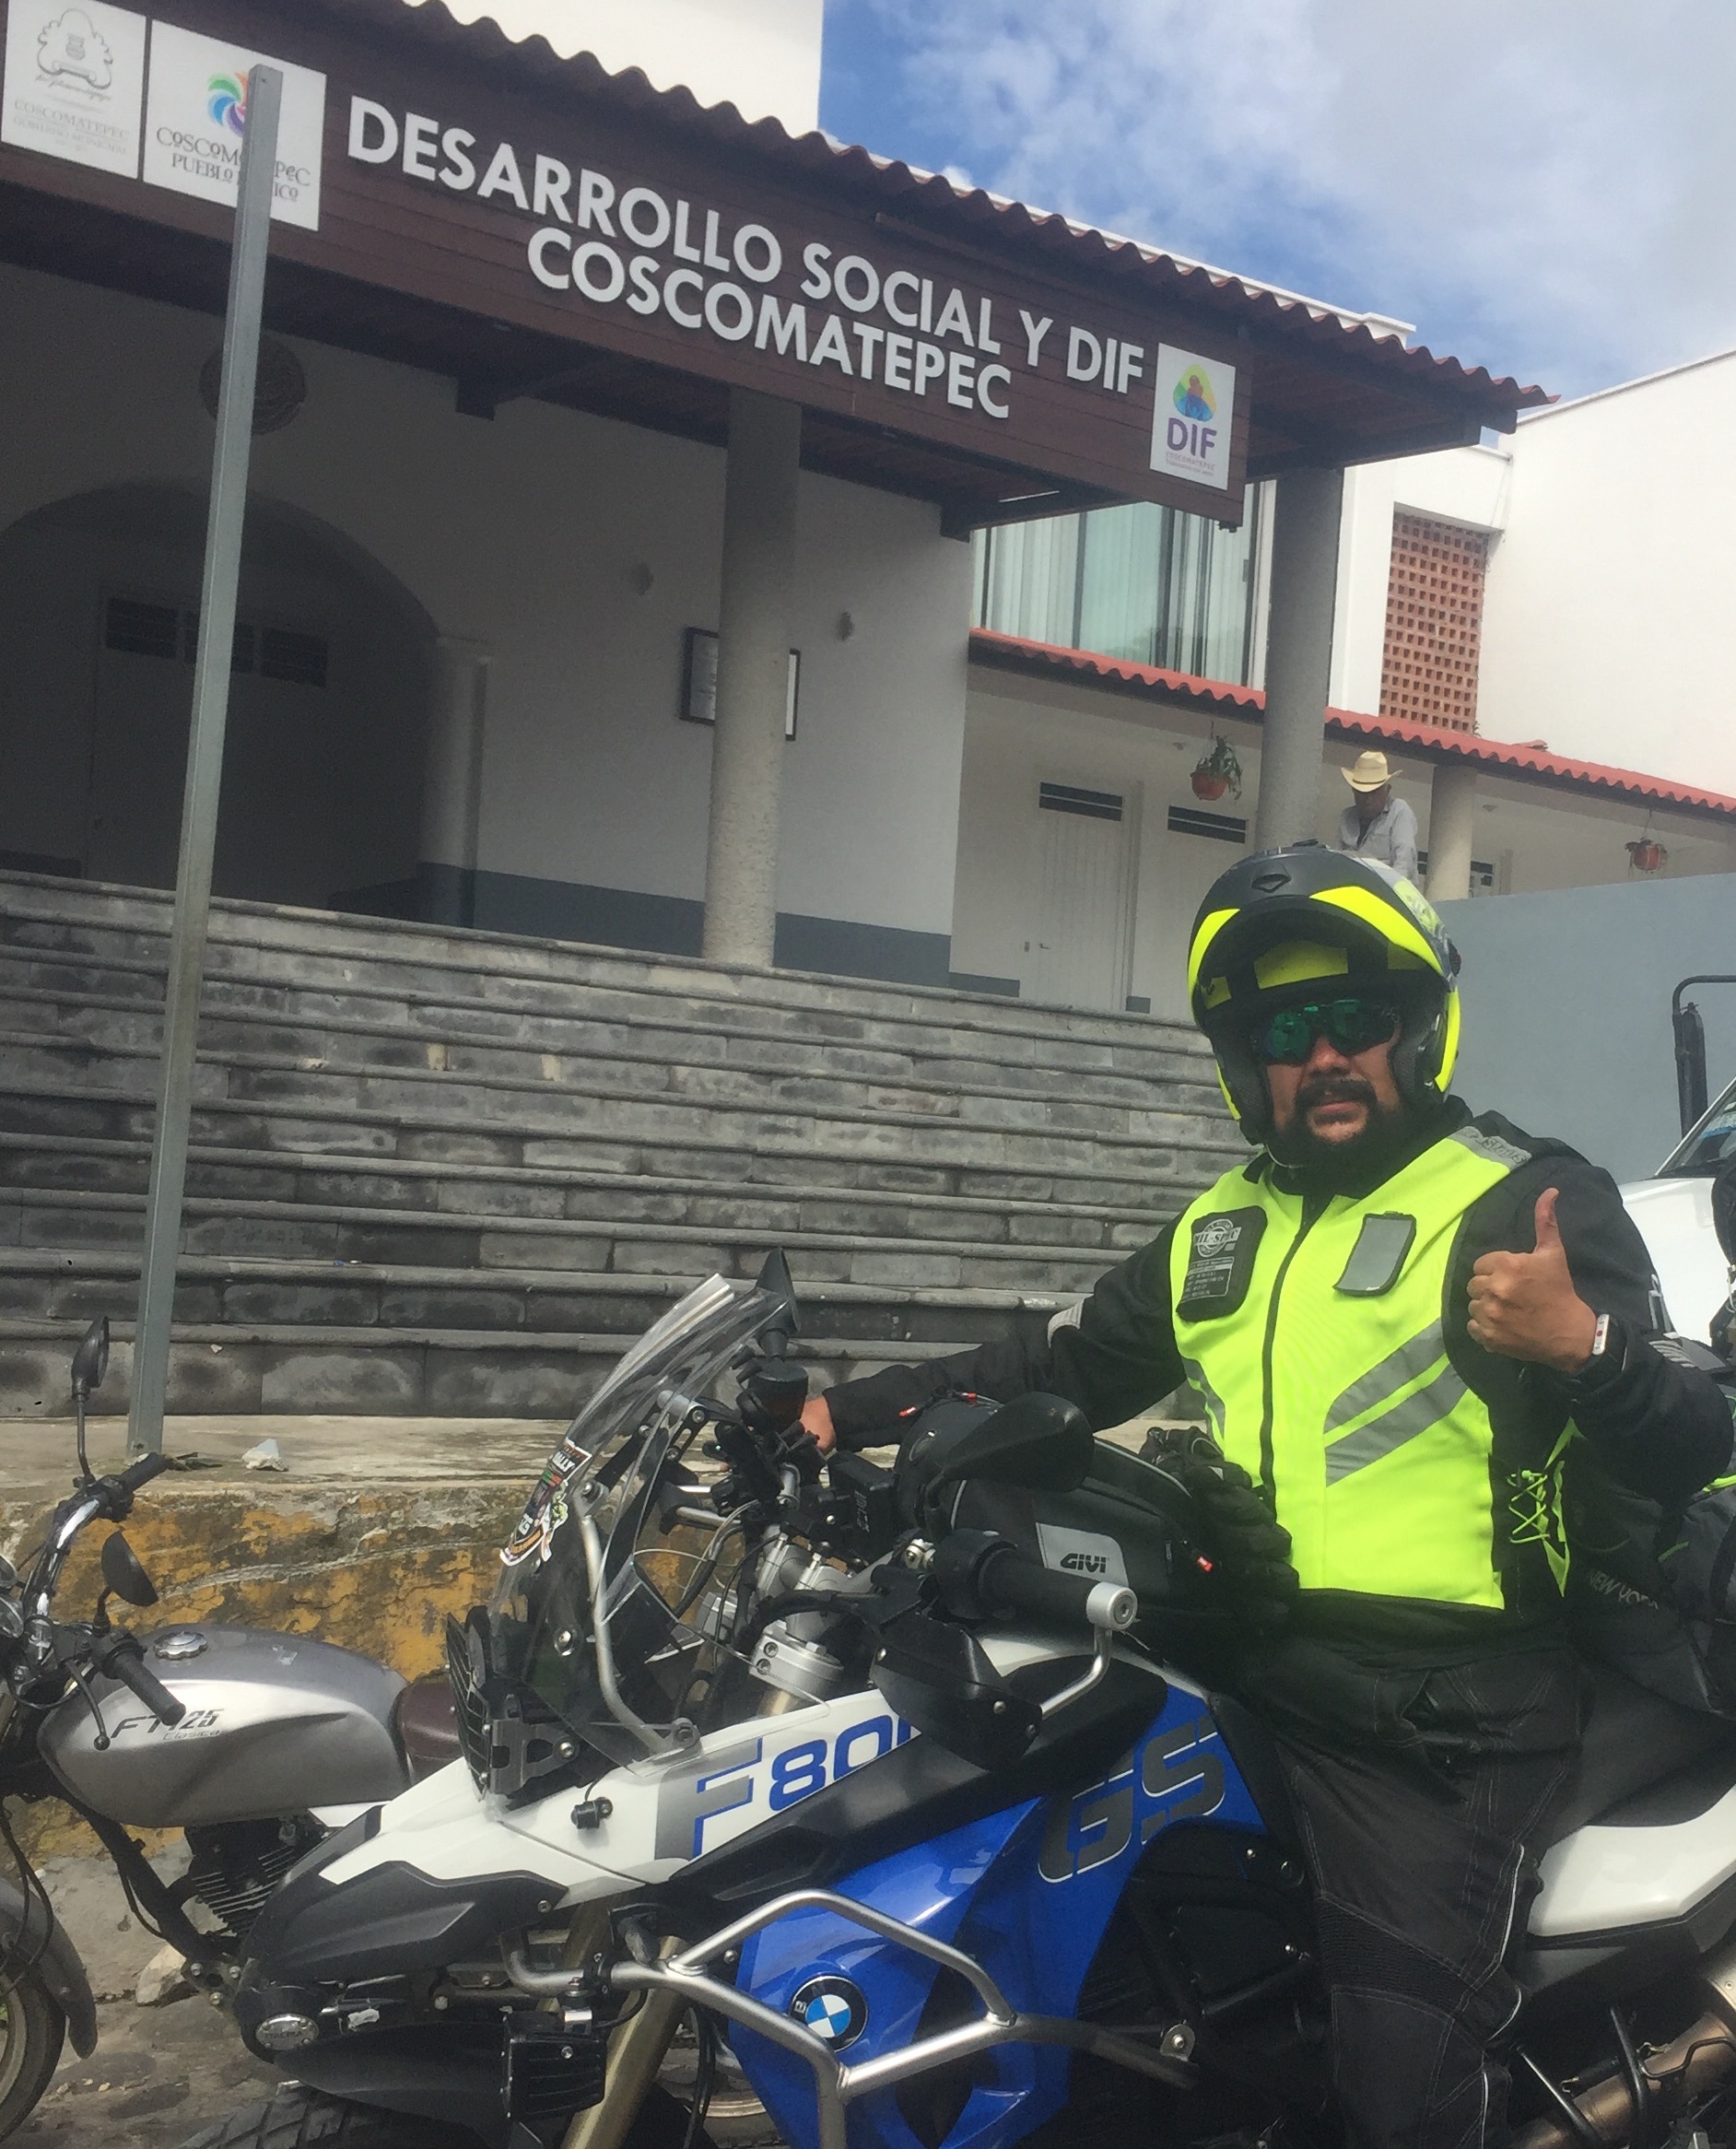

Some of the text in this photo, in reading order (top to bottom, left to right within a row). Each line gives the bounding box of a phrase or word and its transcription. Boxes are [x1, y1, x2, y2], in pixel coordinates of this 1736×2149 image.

[347, 95, 1144, 394] DESARROLLO SOCIAL Y DIF
[528, 227, 1012, 419] COSCOMATEPEC
[1167, 417, 1217, 459] DIF
[1060, 1553, 1108, 1573] GIVI
[110, 1709, 224, 1739] FT25
[1038, 1716, 1226, 1884] GS
